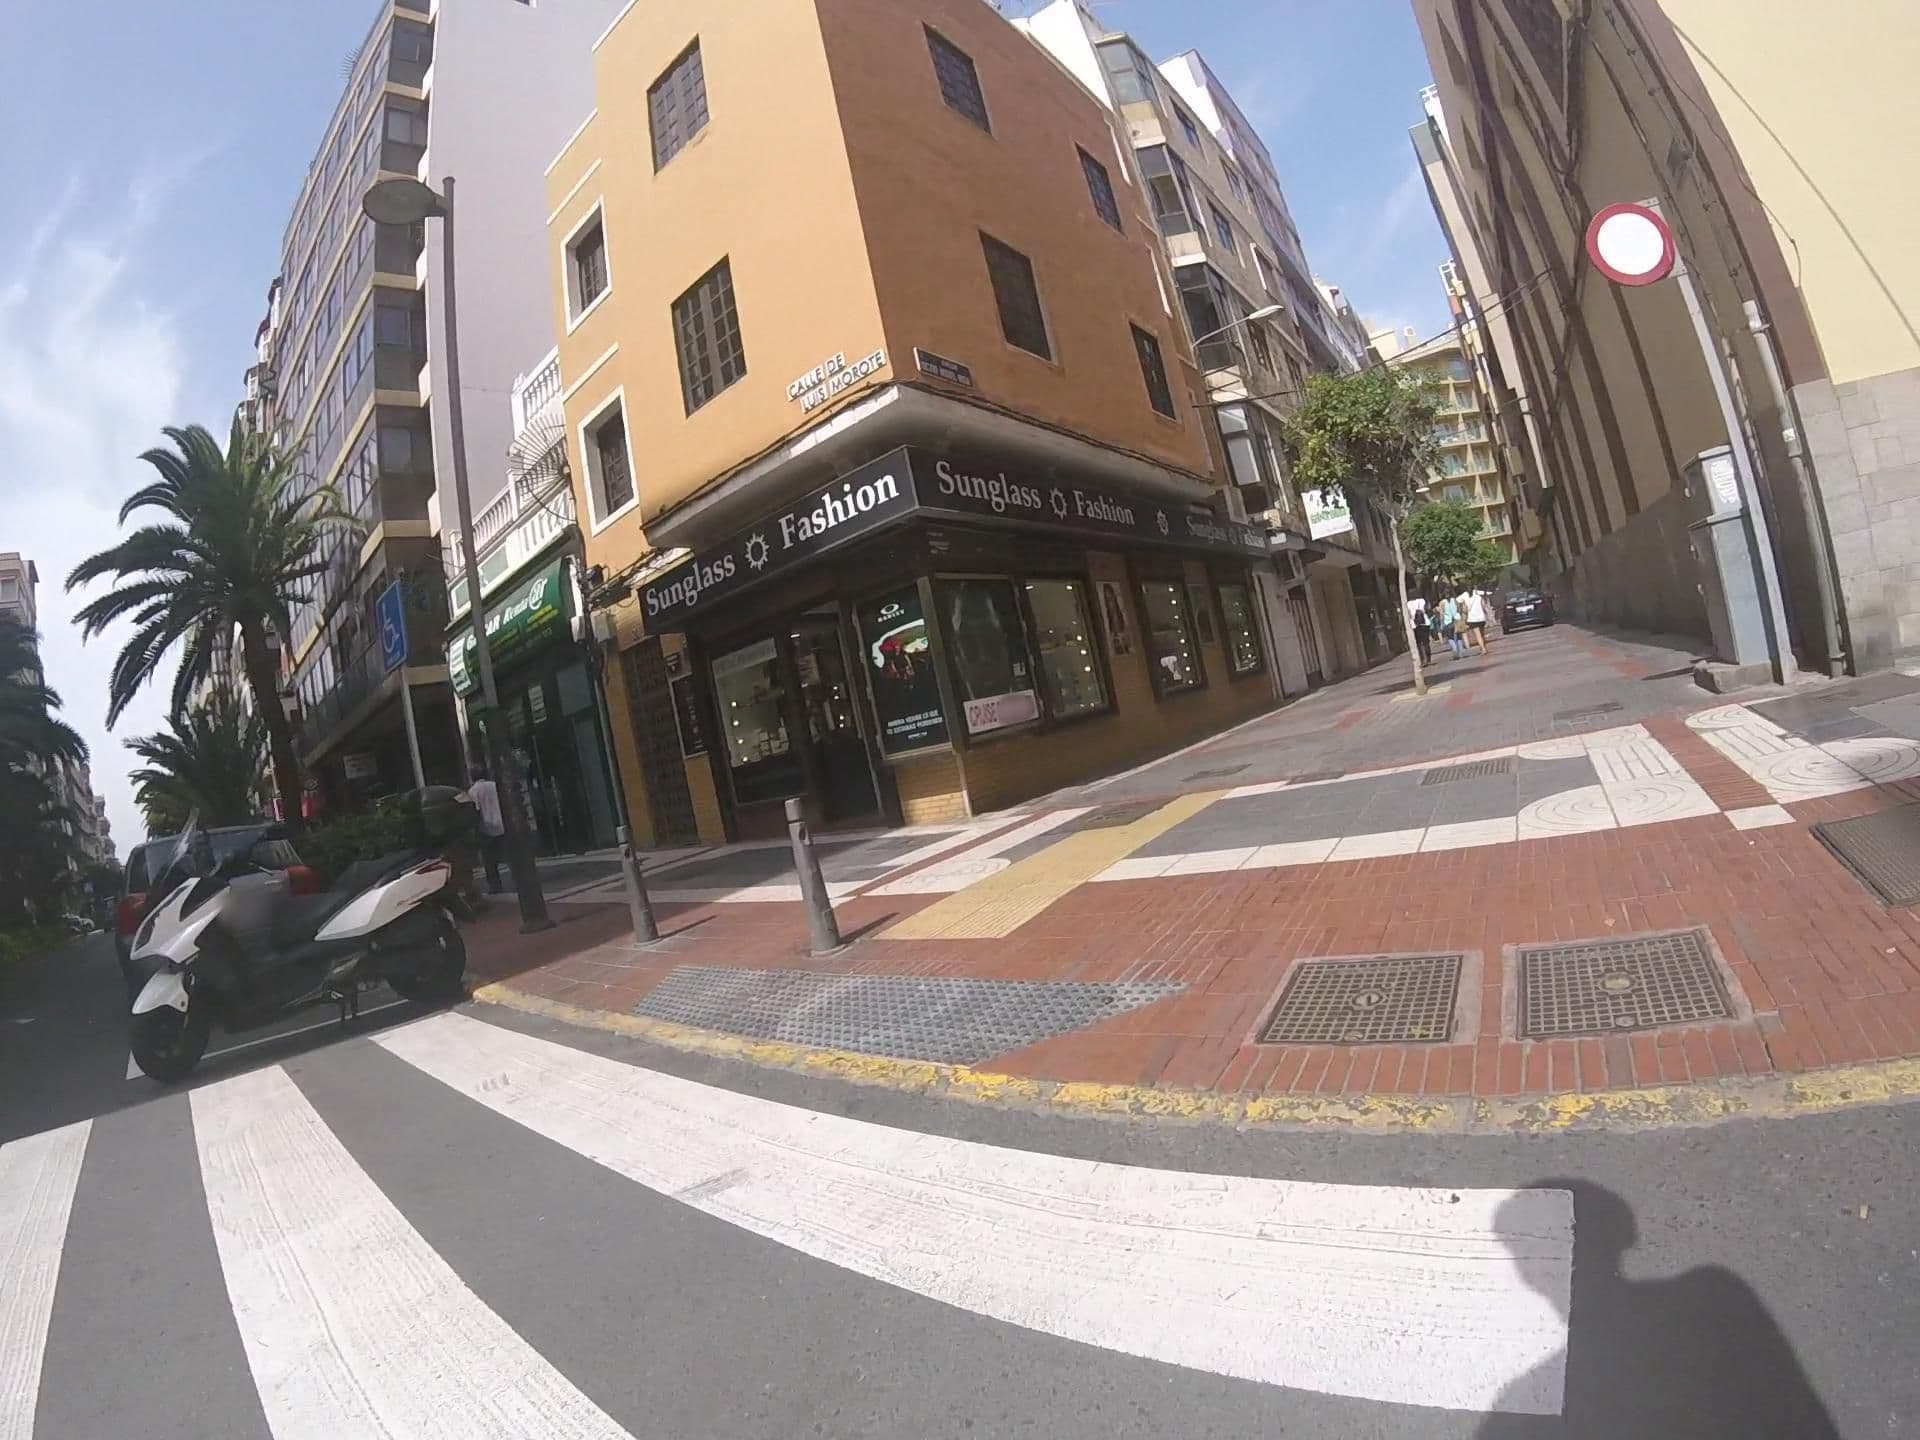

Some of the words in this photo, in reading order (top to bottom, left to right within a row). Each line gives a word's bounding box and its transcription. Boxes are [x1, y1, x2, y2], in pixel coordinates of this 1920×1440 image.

[789, 367, 822, 398] CALLE
[827, 354, 843, 373] DE
[802, 387, 825, 411] LUIS
[832, 351, 883, 392] MOROTE
[936, 460, 1043, 513] Sunglass
[1072, 490, 1136, 526] Fashion
[645, 553, 736, 617] Sunglass
[778, 473, 900, 550] Fashion
